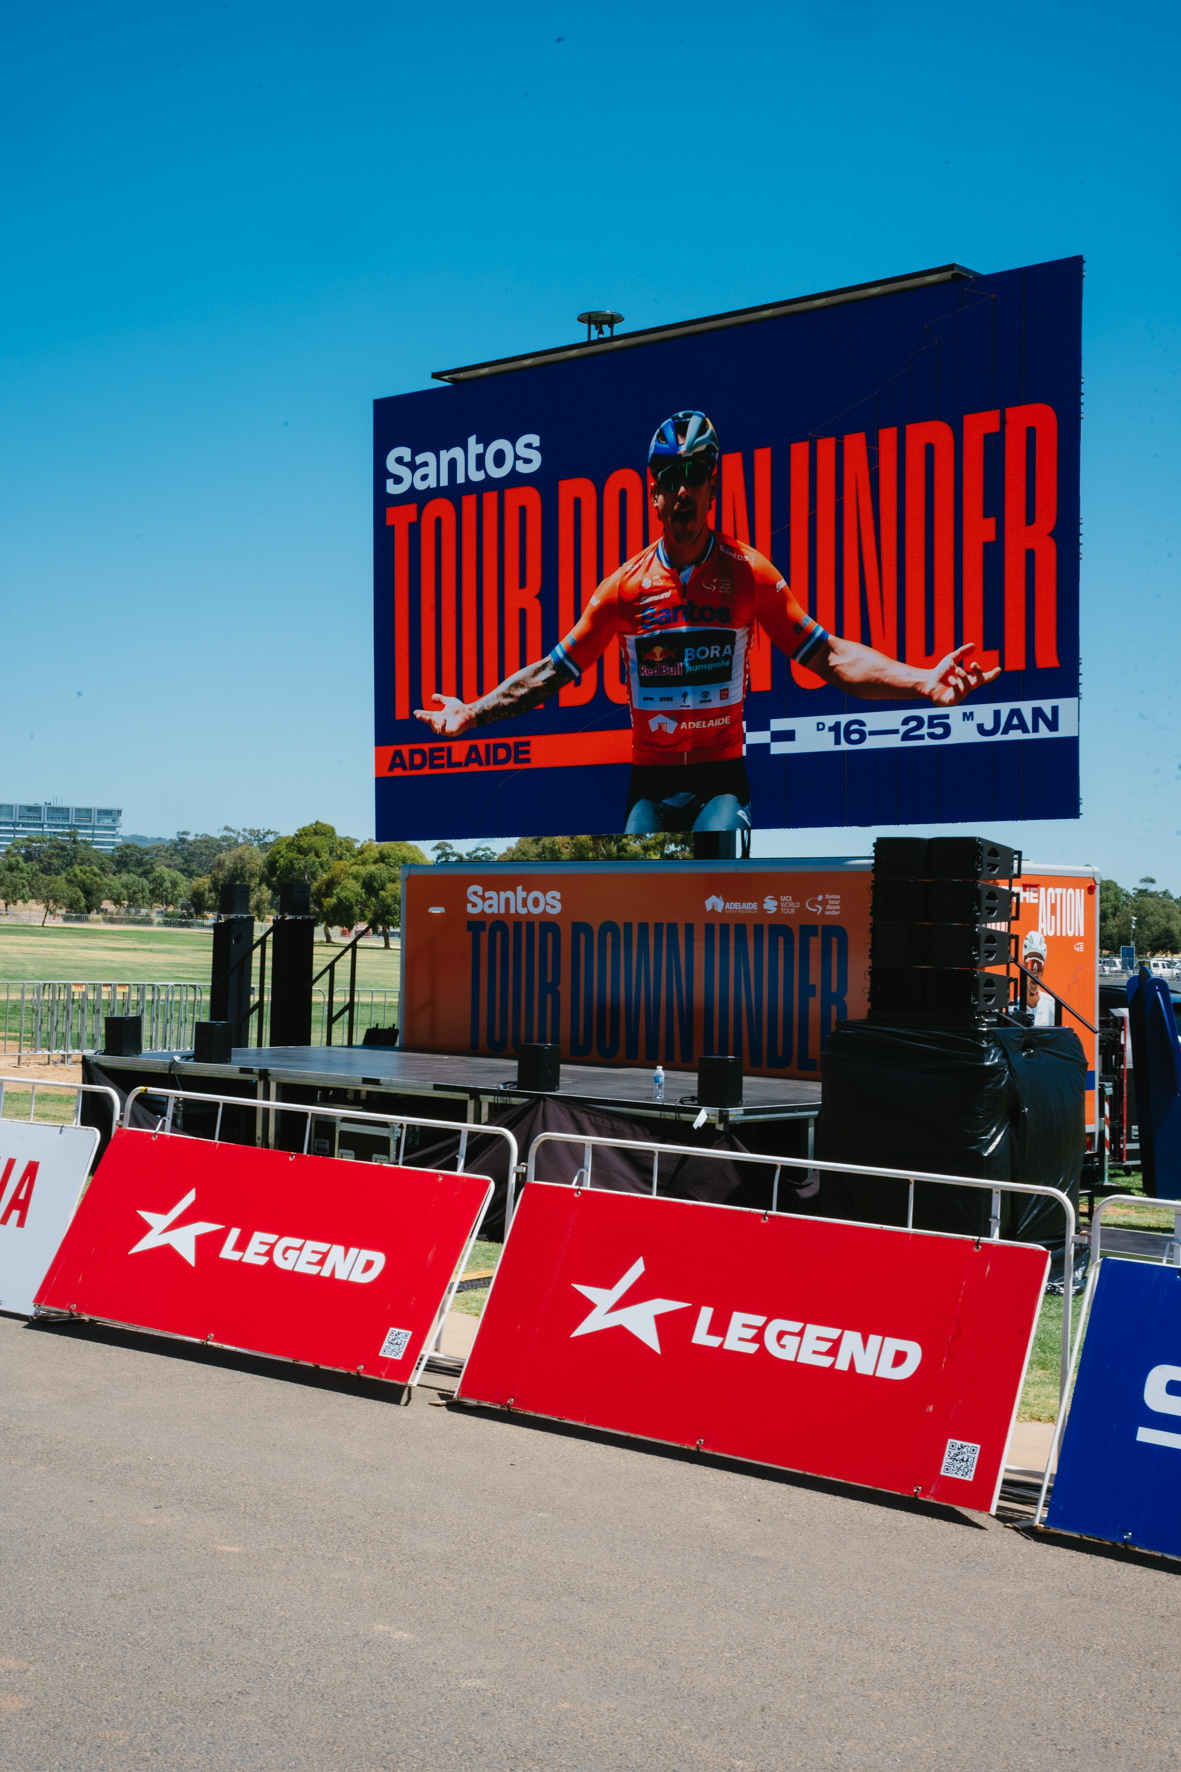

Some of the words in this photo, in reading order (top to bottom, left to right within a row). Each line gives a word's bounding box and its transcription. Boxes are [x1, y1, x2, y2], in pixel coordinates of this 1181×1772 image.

[386, 433, 543, 495] Santos
[386, 485, 545, 720] TOUR
[558, 446, 772, 709] DON
[789, 402, 1061, 690] UNDER
[639, 664, 659, 676] Red
[660, 662, 683, 676] Bull
[684, 644, 733, 662] BORA
[680, 716, 731, 730] ADELAIDE
[976, 704, 1060, 738] JAN
[387, 740, 532, 772] ADELAIDE
[466, 885, 562, 915] Santos
[725, 902, 758, 910] ADELAIDE
[1038, 887, 1085, 937] ACTION
[467, 920, 562, 1053] TOUR
[569, 920, 695, 1064] DOWN
[703, 923, 849, 1073] UNDER
[218, 1227, 387, 1284] LEGEND
[691, 1306, 923, 1381] LEGEND
